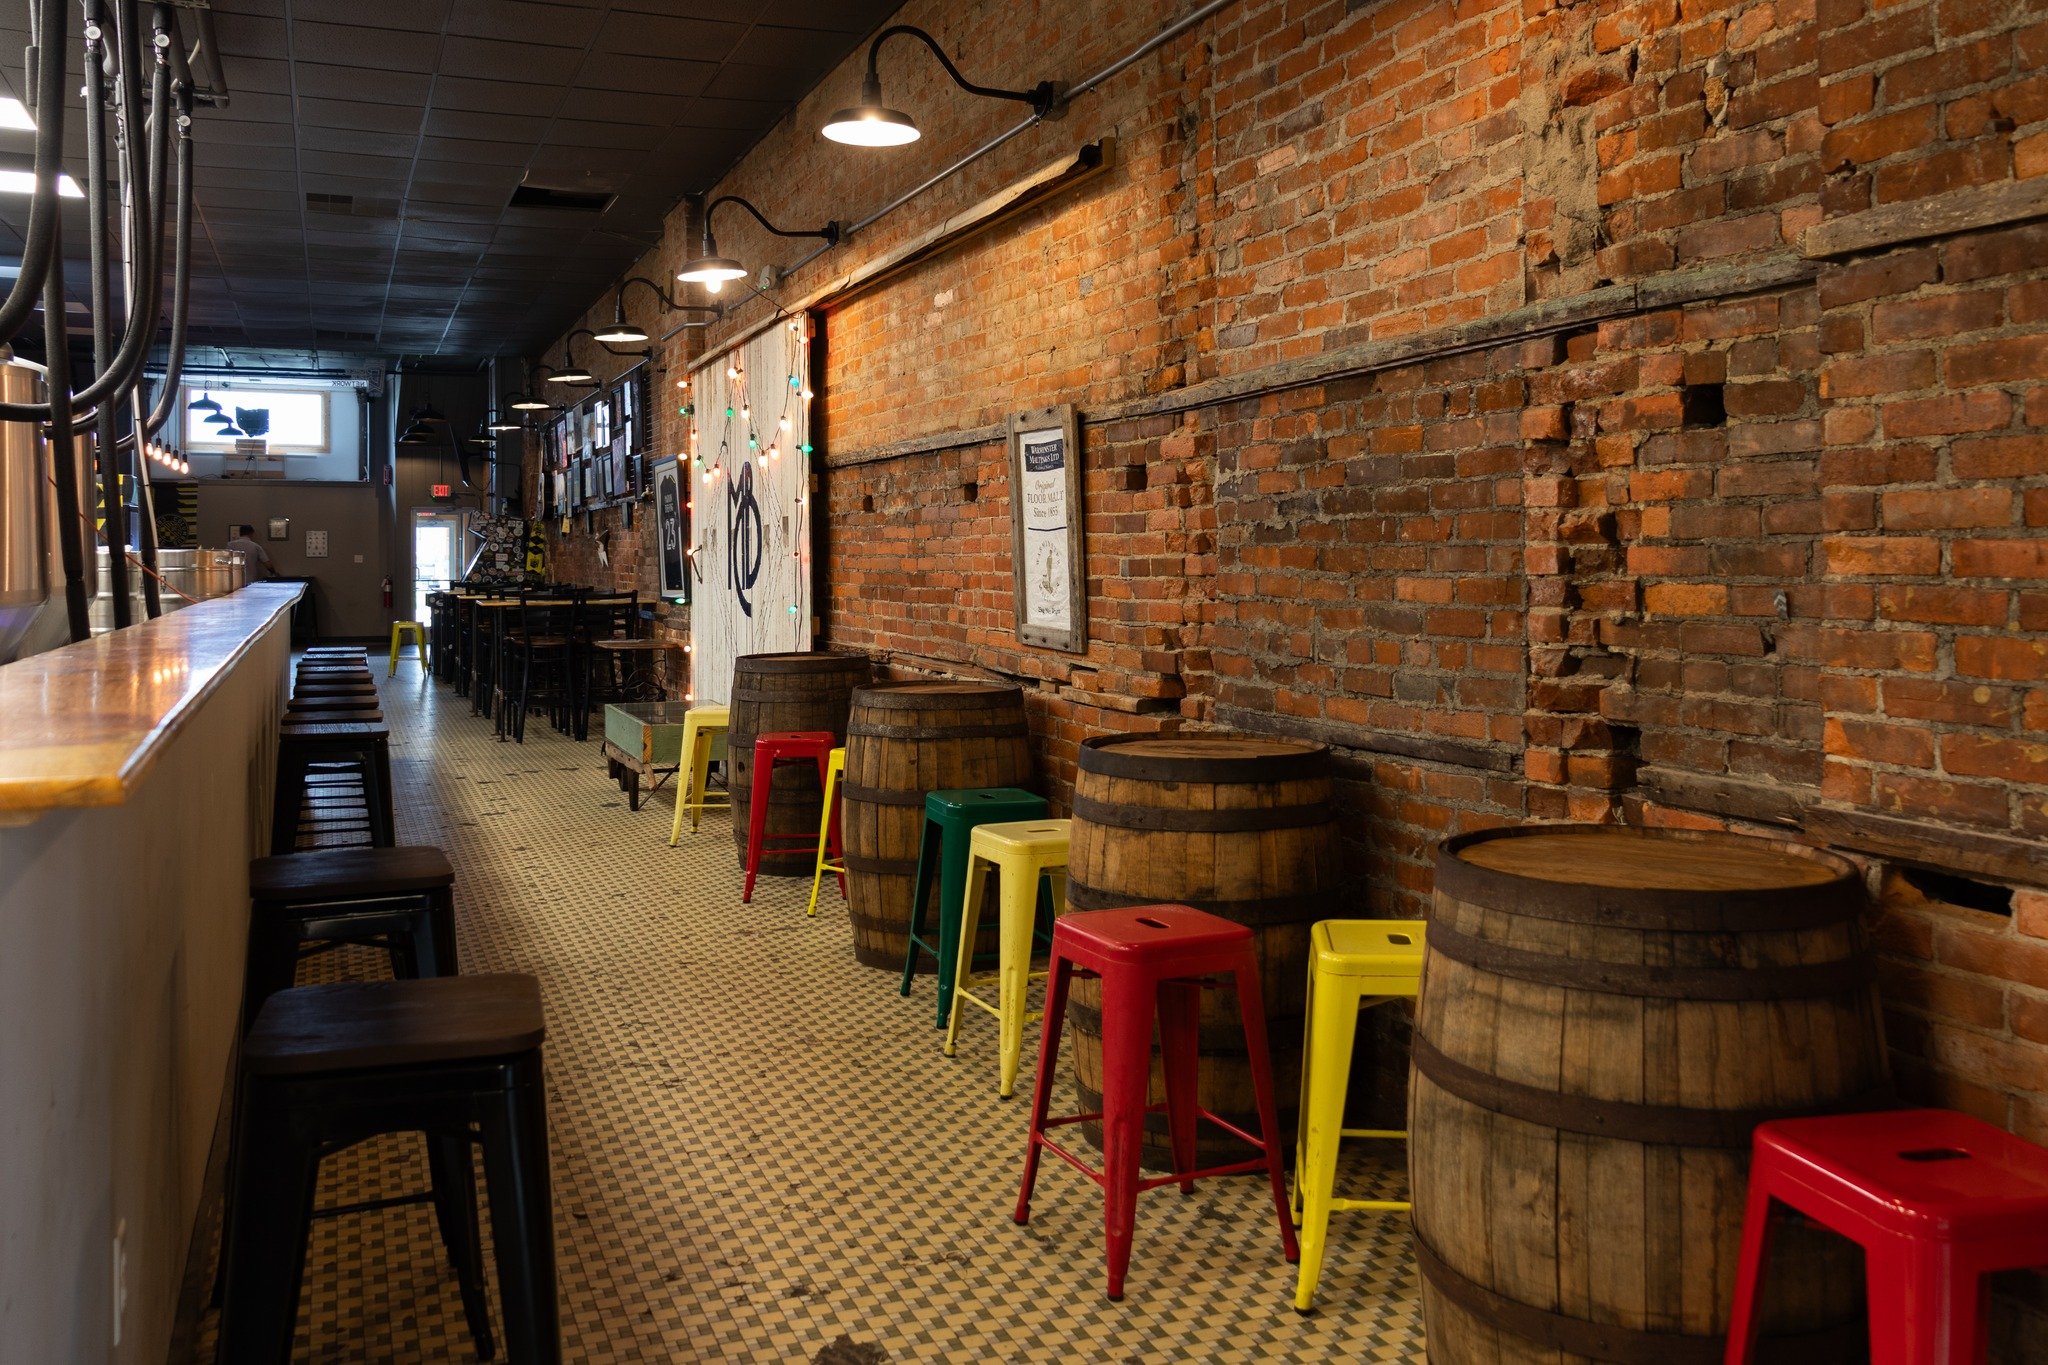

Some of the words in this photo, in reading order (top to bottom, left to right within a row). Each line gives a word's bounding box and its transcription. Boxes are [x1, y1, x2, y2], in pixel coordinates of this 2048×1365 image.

[433, 484, 449, 497] EXIT
[1027, 493, 1047, 504] FLOOR
[1047, 489, 1064, 502] MALT
[1033, 507, 1047, 518] Since
